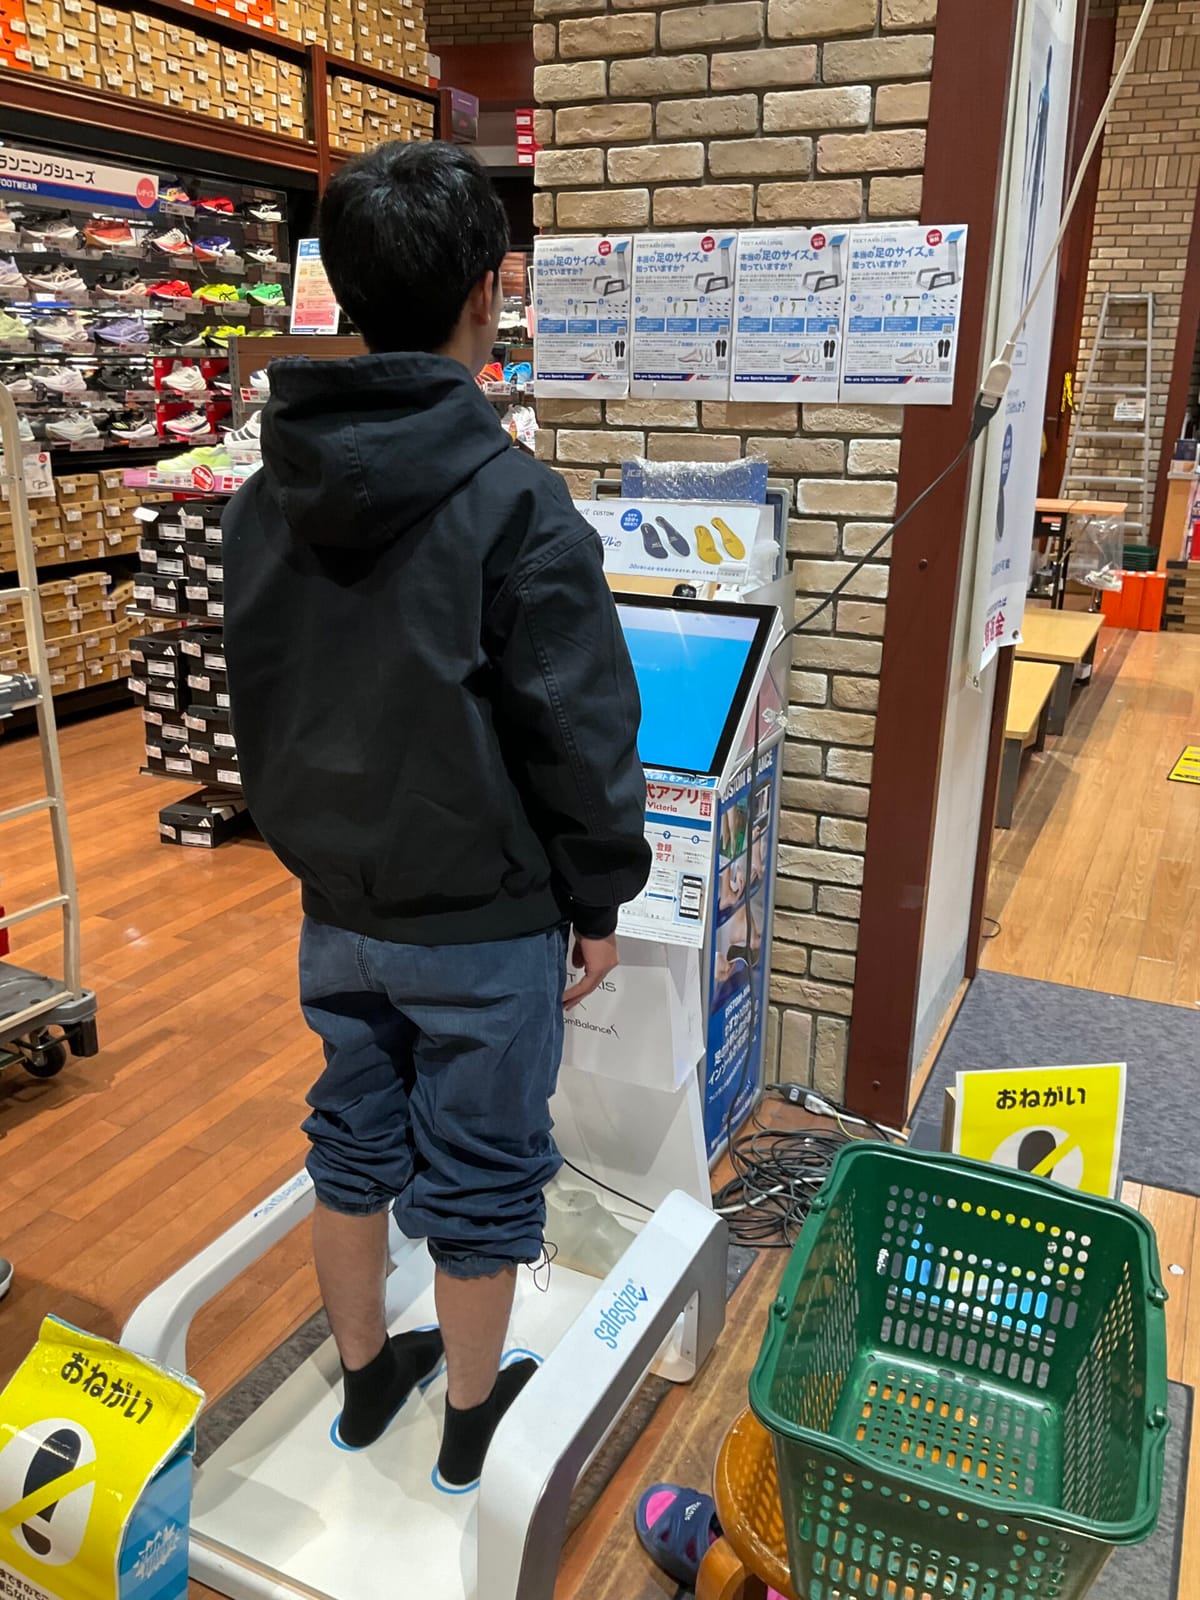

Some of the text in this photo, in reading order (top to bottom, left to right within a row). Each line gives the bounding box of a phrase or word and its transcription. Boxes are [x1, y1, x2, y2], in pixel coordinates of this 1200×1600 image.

[0, 154, 95, 185] ランニングシューズ
[647, 801, 678, 813] Victoria
[563, 1017, 612, 1035] omBalance
[996, 1085, 1087, 1110] おねがい
[60, 1351, 154, 1425] おねがい
